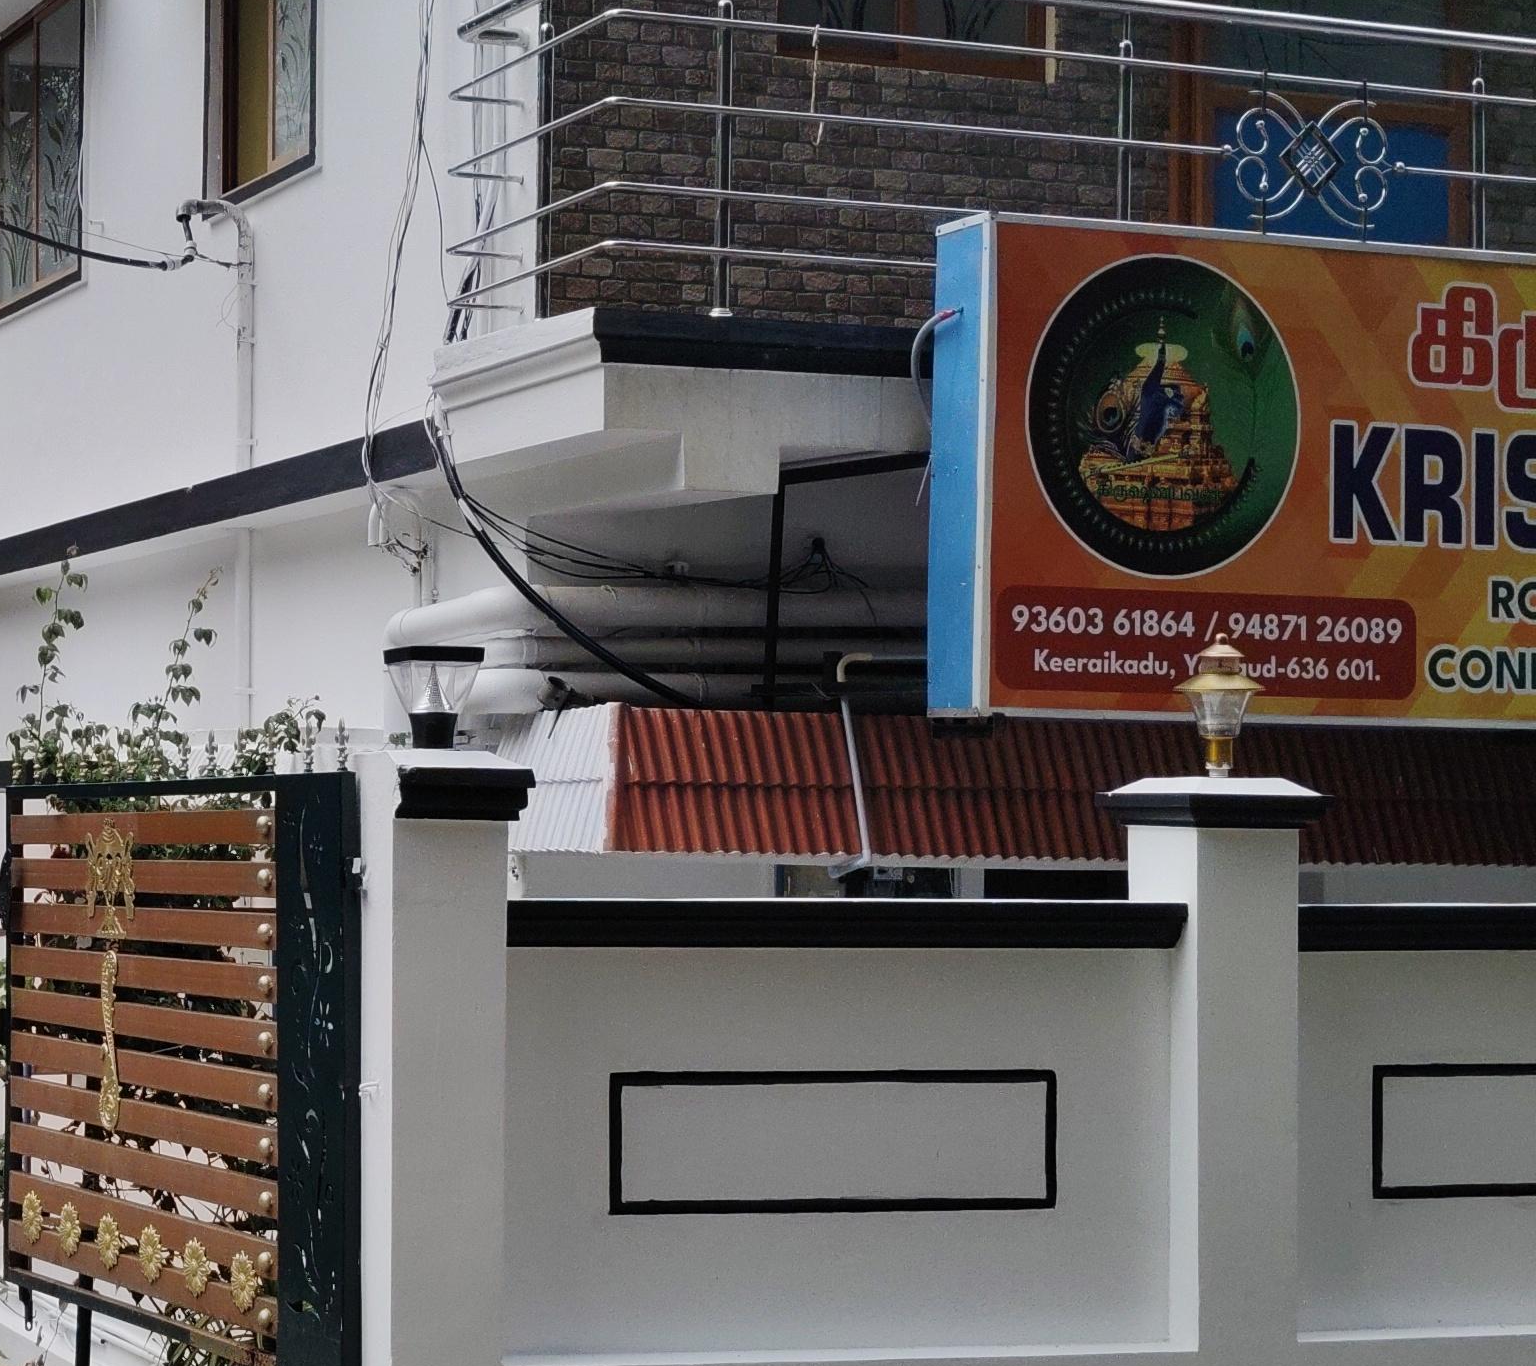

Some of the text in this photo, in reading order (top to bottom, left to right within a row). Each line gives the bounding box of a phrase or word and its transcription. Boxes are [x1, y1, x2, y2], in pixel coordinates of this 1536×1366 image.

[1011, 604, 1403, 645] 93603 61864 / 94871 26089
[1033, 648, 1382, 682] Keeraikadu, Yaud-636 601.
[1427, 648, 1536, 691] CON
